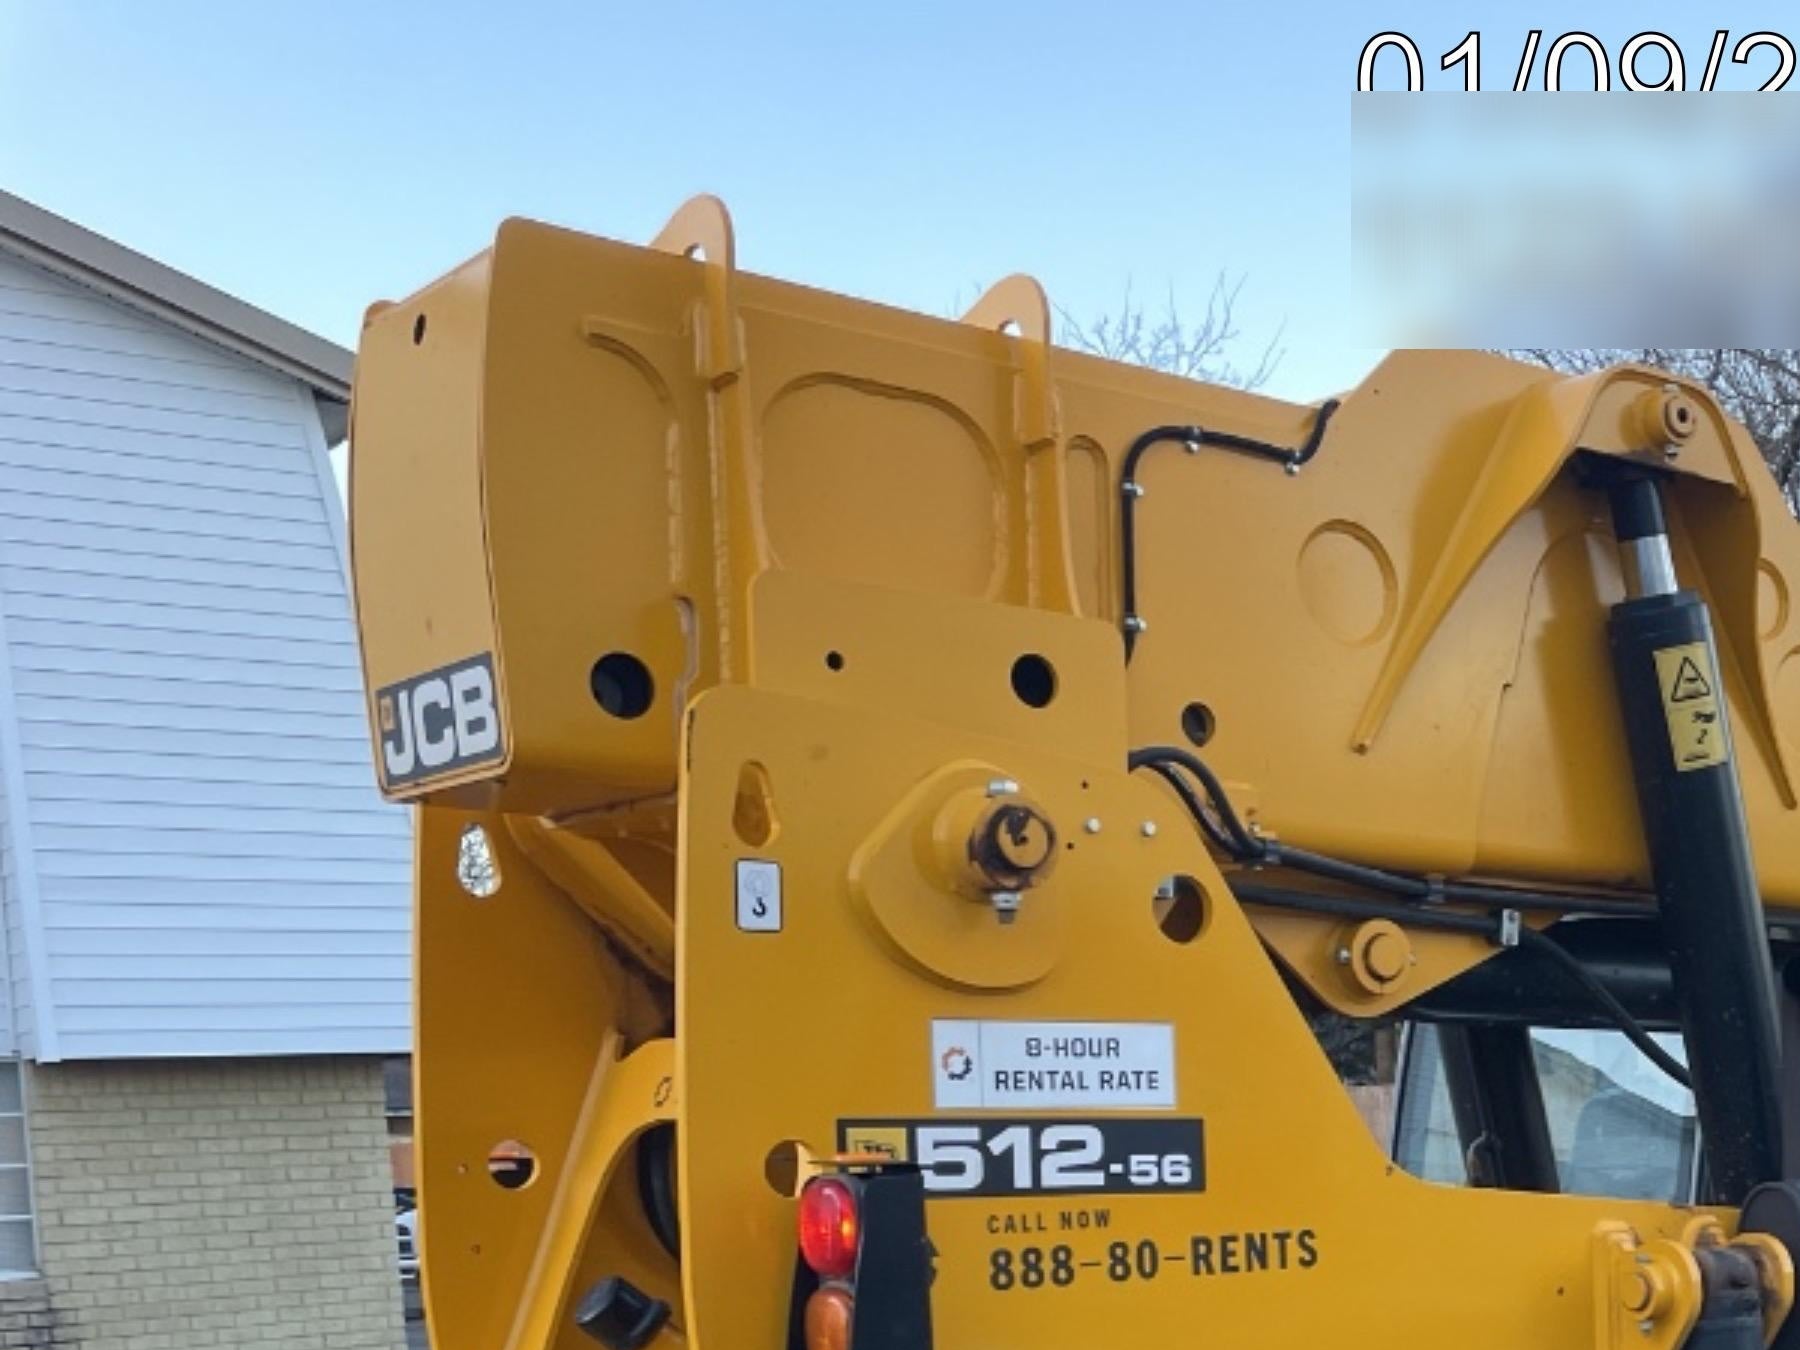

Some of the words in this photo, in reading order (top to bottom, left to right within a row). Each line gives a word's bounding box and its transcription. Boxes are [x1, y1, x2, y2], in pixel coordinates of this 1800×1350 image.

[384, 664, 499, 776] JCB
[1025, 1036, 1121, 1059] 8-HOUR
[994, 1069, 1090, 1092] RENTAL
[1100, 1069, 1160, 1091] RATE
[987, 1212, 1048, 1234] CALL
[1059, 1208, 1111, 1231] NOW
[989, 1229, 1319, 1291] 888-80-RENTS
